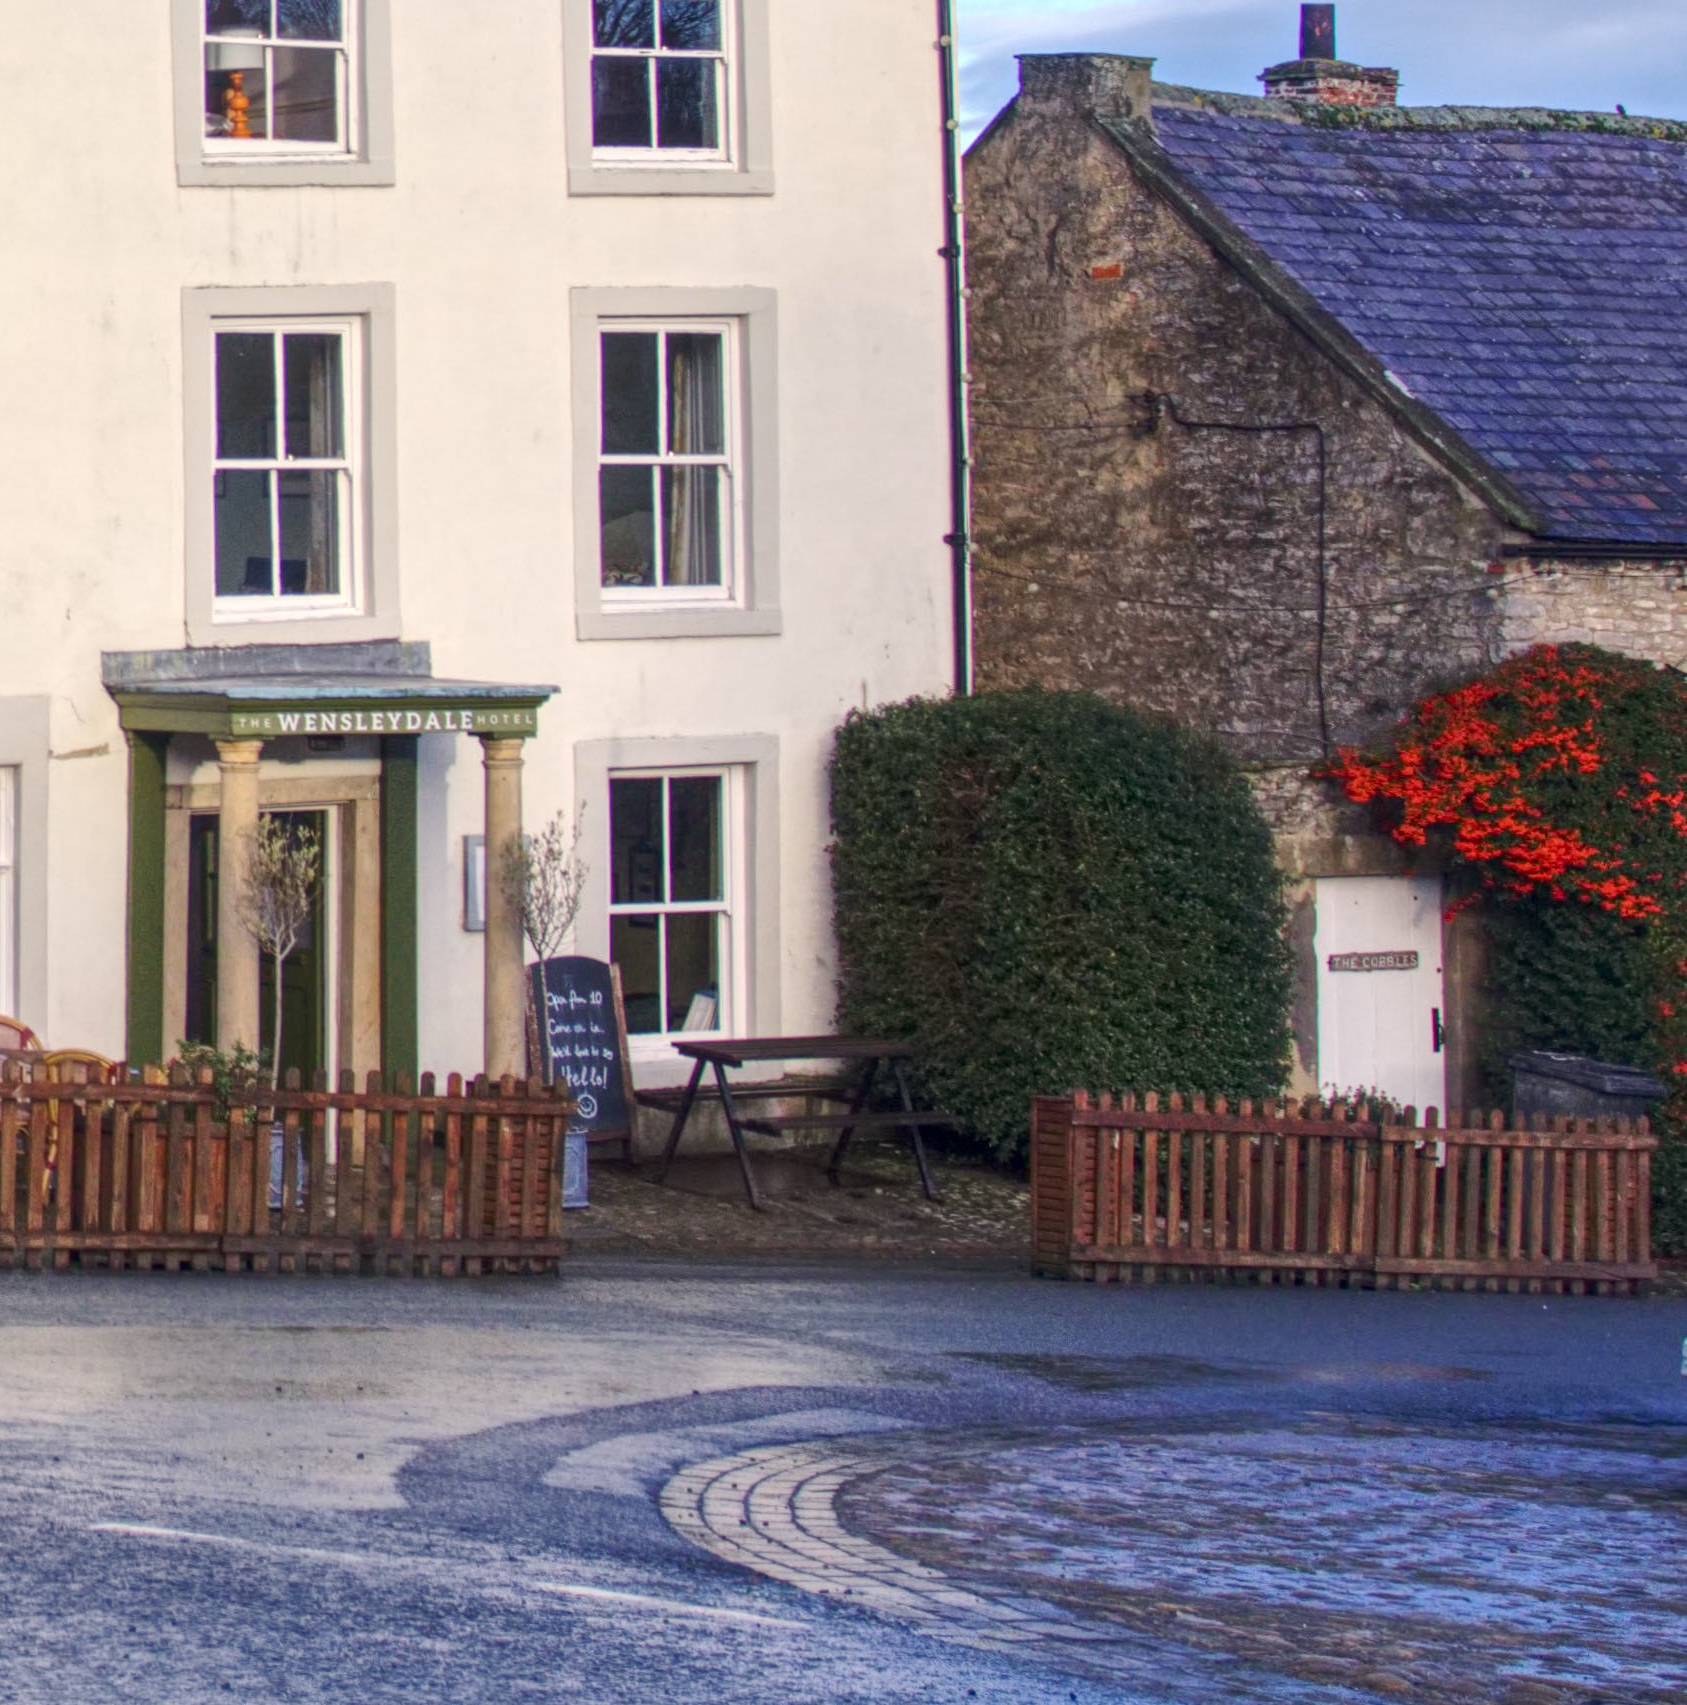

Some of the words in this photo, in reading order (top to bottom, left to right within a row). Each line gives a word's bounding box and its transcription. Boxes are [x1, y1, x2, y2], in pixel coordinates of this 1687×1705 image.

[239, 718, 272, 729] THE
[277, 711, 473, 733] WENSLEYDALE
[477, 713, 533, 725] HOTEL
[1333, 957, 1357, 970] THE
[1362, 954, 1417, 969] COBBLES
[590, 990, 603, 1005] 10
